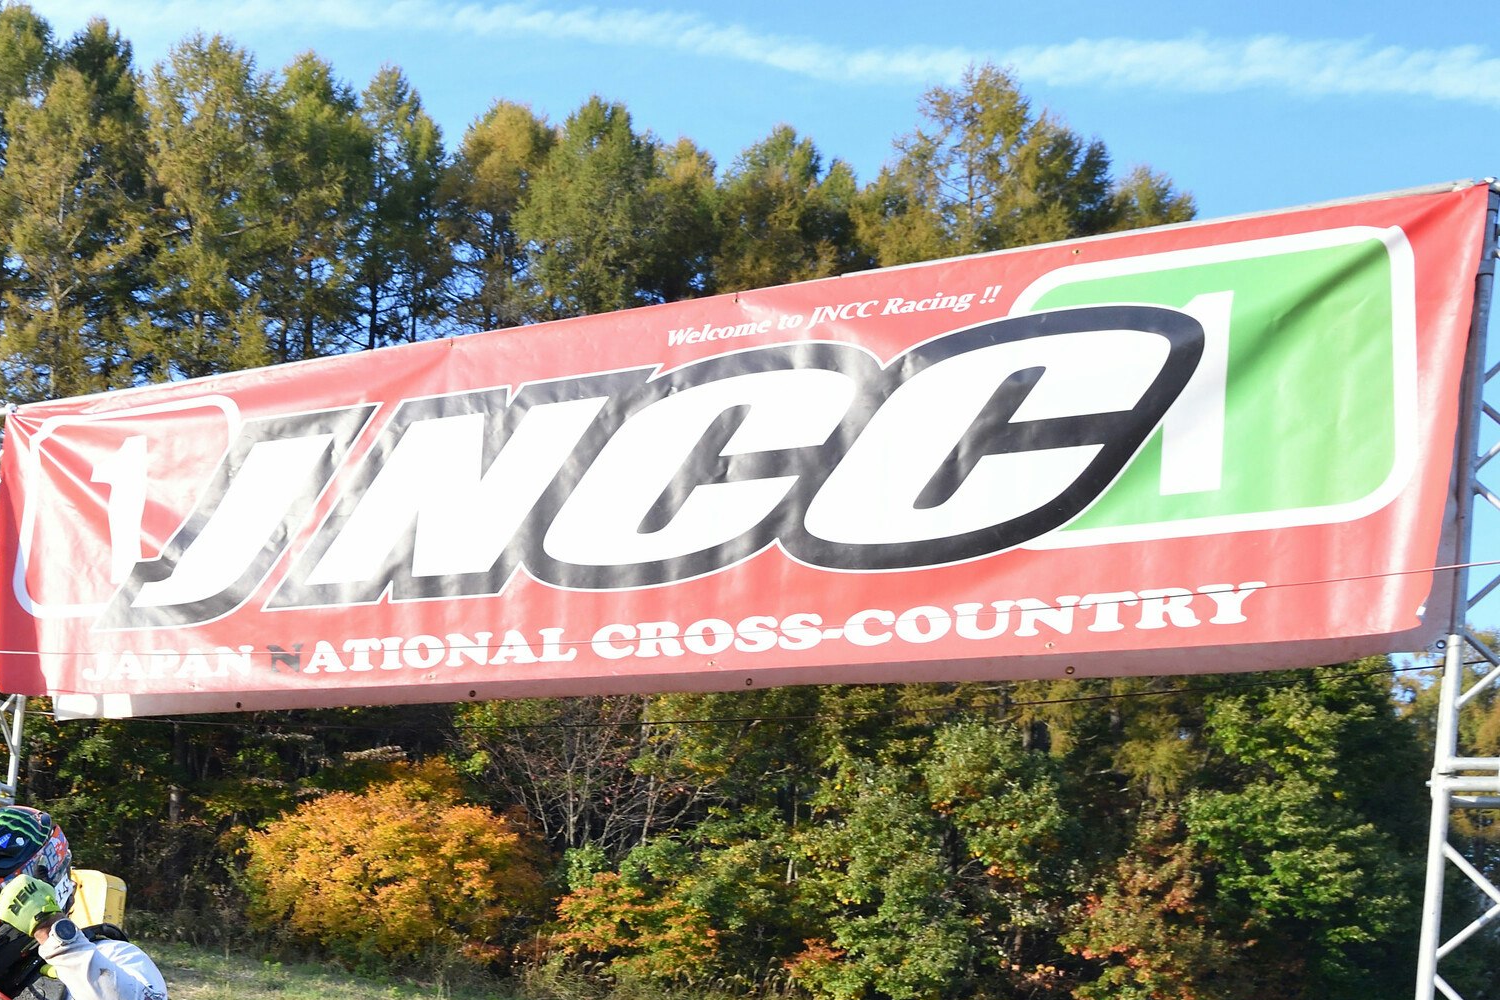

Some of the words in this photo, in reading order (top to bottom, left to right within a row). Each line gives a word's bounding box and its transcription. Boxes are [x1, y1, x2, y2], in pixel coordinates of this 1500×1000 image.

[667, 318, 771, 347] Welcome
[777, 314, 804, 330] to
[806, 300, 882, 329] JNCC
[881, 292, 976, 315] Racing
[97, 306, 1205, 630] JNCC
[82, 644, 255, 683] JAPAN
[266, 628, 578, 676] NATIONAL
[590, 581, 1268, 660] CROSS-COUNTRY
